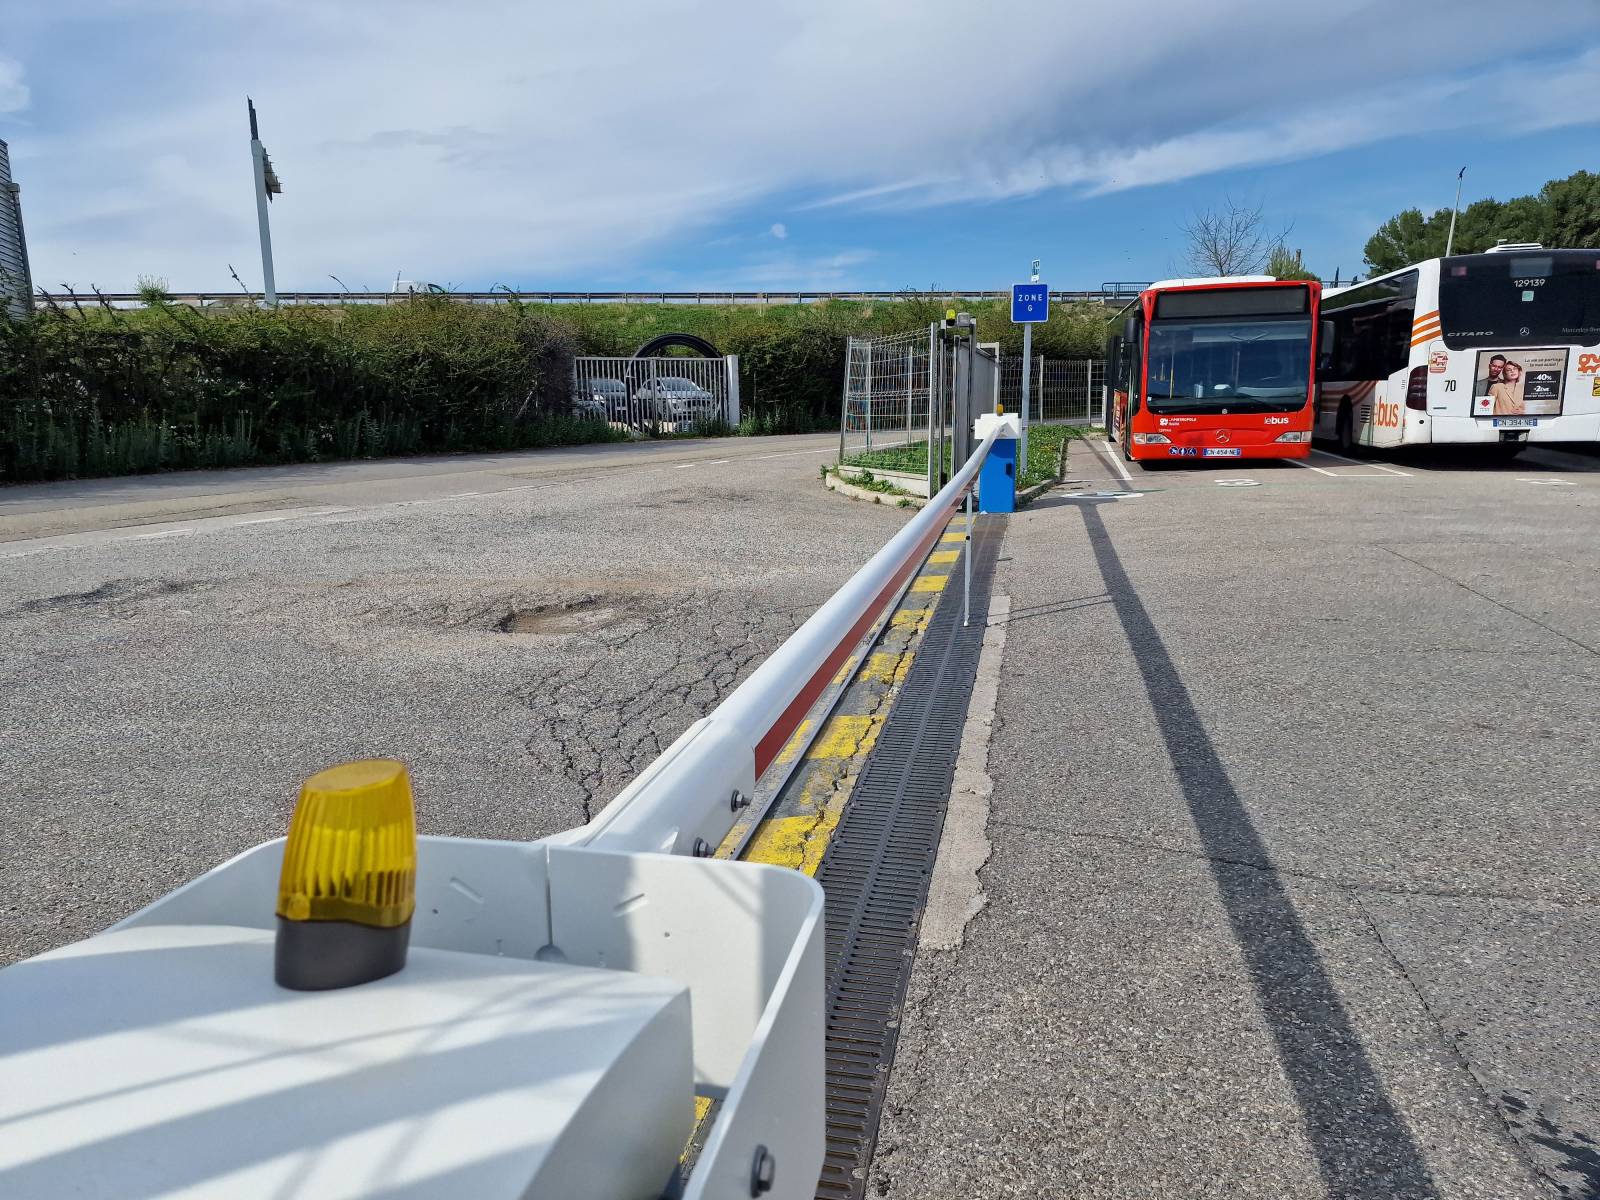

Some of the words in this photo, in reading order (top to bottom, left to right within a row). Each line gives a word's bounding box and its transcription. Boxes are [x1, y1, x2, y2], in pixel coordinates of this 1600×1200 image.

[1513, 278, 1546, 288] 129139
[1018, 294, 1043, 302] ZONE
[1027, 304, 1033, 312] G
[1444, 379, 1456, 392] 70
[1264, 416, 1289, 425] lebus
